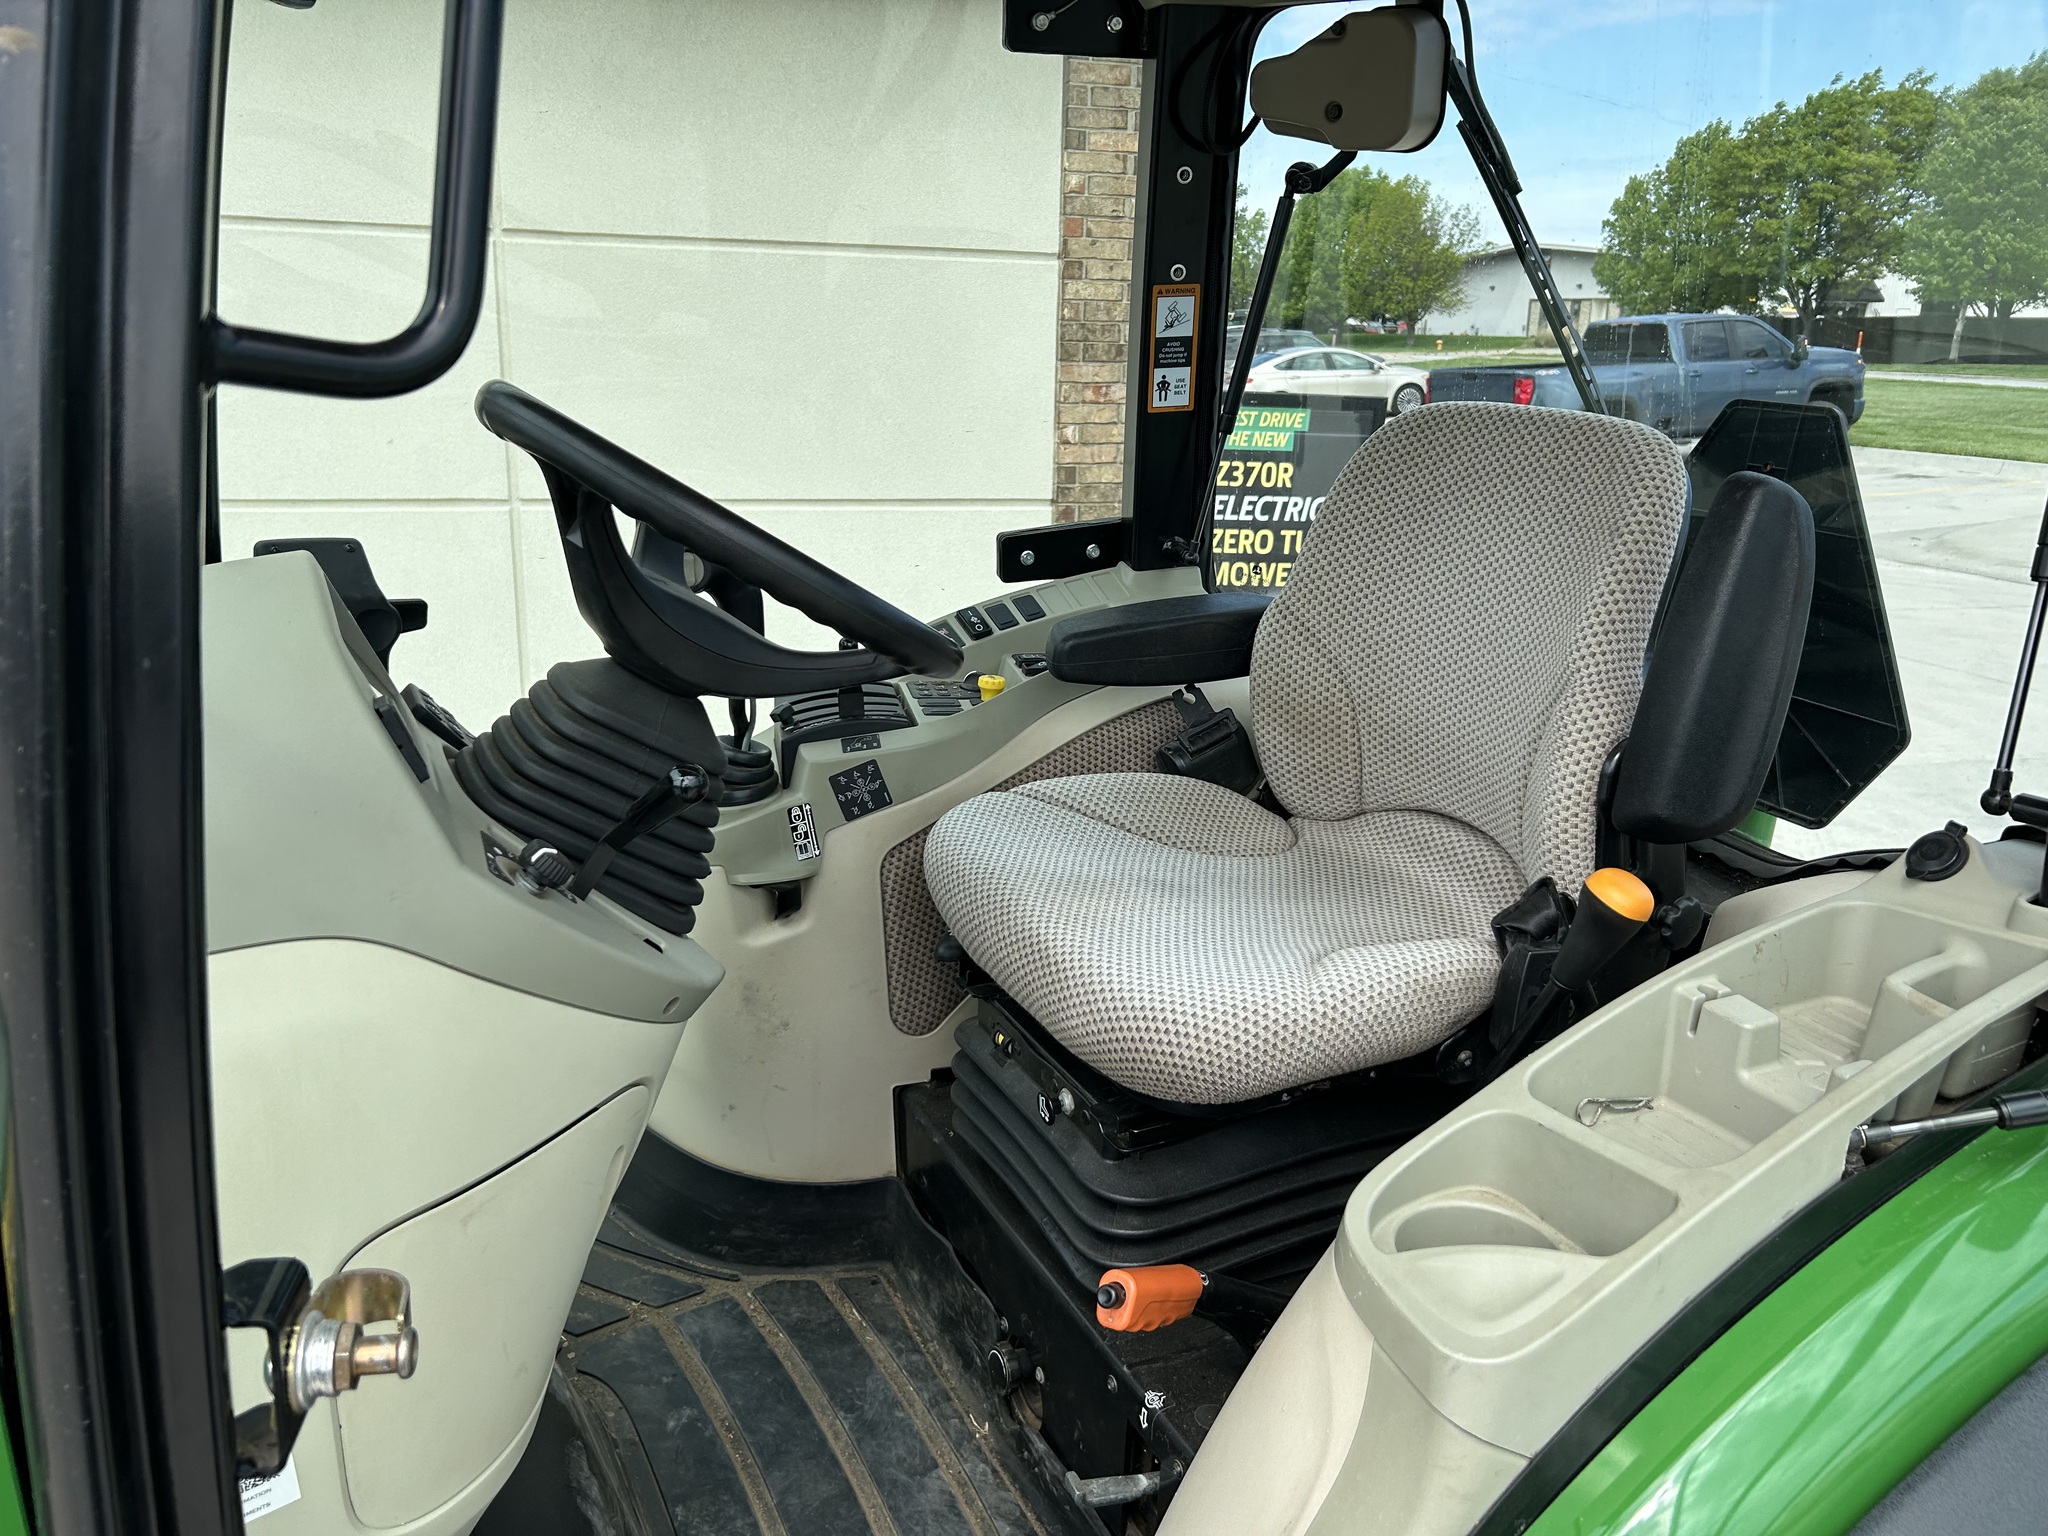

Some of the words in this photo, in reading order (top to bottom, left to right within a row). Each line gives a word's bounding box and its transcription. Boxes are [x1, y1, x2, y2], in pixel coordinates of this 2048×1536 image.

[1259, 411, 1305, 429] DRIVE
[1228, 431, 1251, 447] HE
[1252, 431, 1290, 448] NEW
[1217, 461, 1294, 488] Z370R
[1212, 529, 1274, 555] ZERO
[1212, 561, 1295, 587] MOWE
[243, 1487, 272, 1503] MATION
